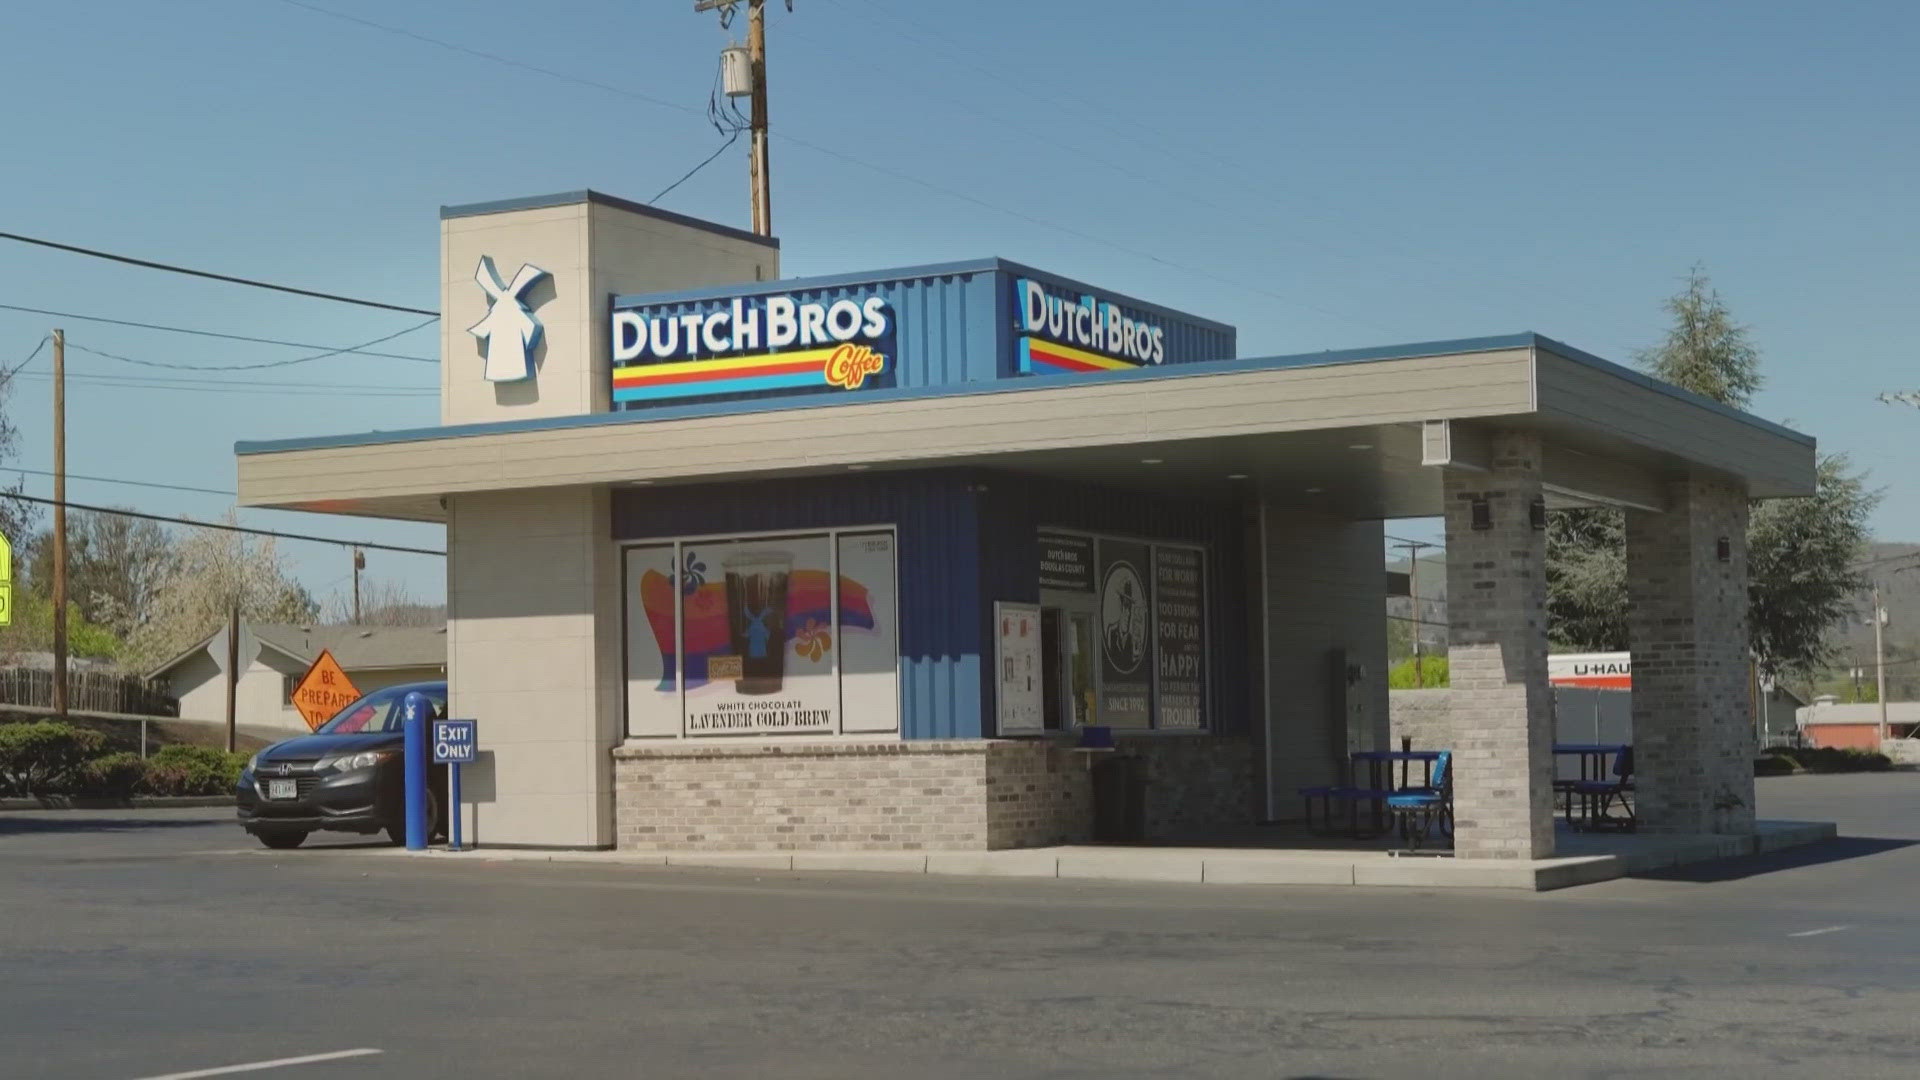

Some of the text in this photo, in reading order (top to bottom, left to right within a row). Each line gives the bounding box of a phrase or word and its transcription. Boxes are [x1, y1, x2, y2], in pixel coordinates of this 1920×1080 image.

[612, 296, 887, 361] DUTCH BROS
[1026, 279, 1164, 365] DUTCH BROS
[825, 343, 884, 388] Coffee
[1160, 621, 1199, 640] FOR FEAR
[1160, 645, 1200, 677] HAPPY
[1574, 663, 1630, 675] U-HAU
[321, 670, 336, 686] BE
[717, 700, 801, 711] WHITE CHOCOLATE
[1108, 697, 1145, 712] SINCE 1992
[309, 710, 323, 725] TO
[690, 709, 831, 729] LAVENDER COLD BREW
[1162, 708, 1200, 726] TROUBLE
[438, 725, 468, 741] EXIT
[436, 742, 470, 758] ONLY
